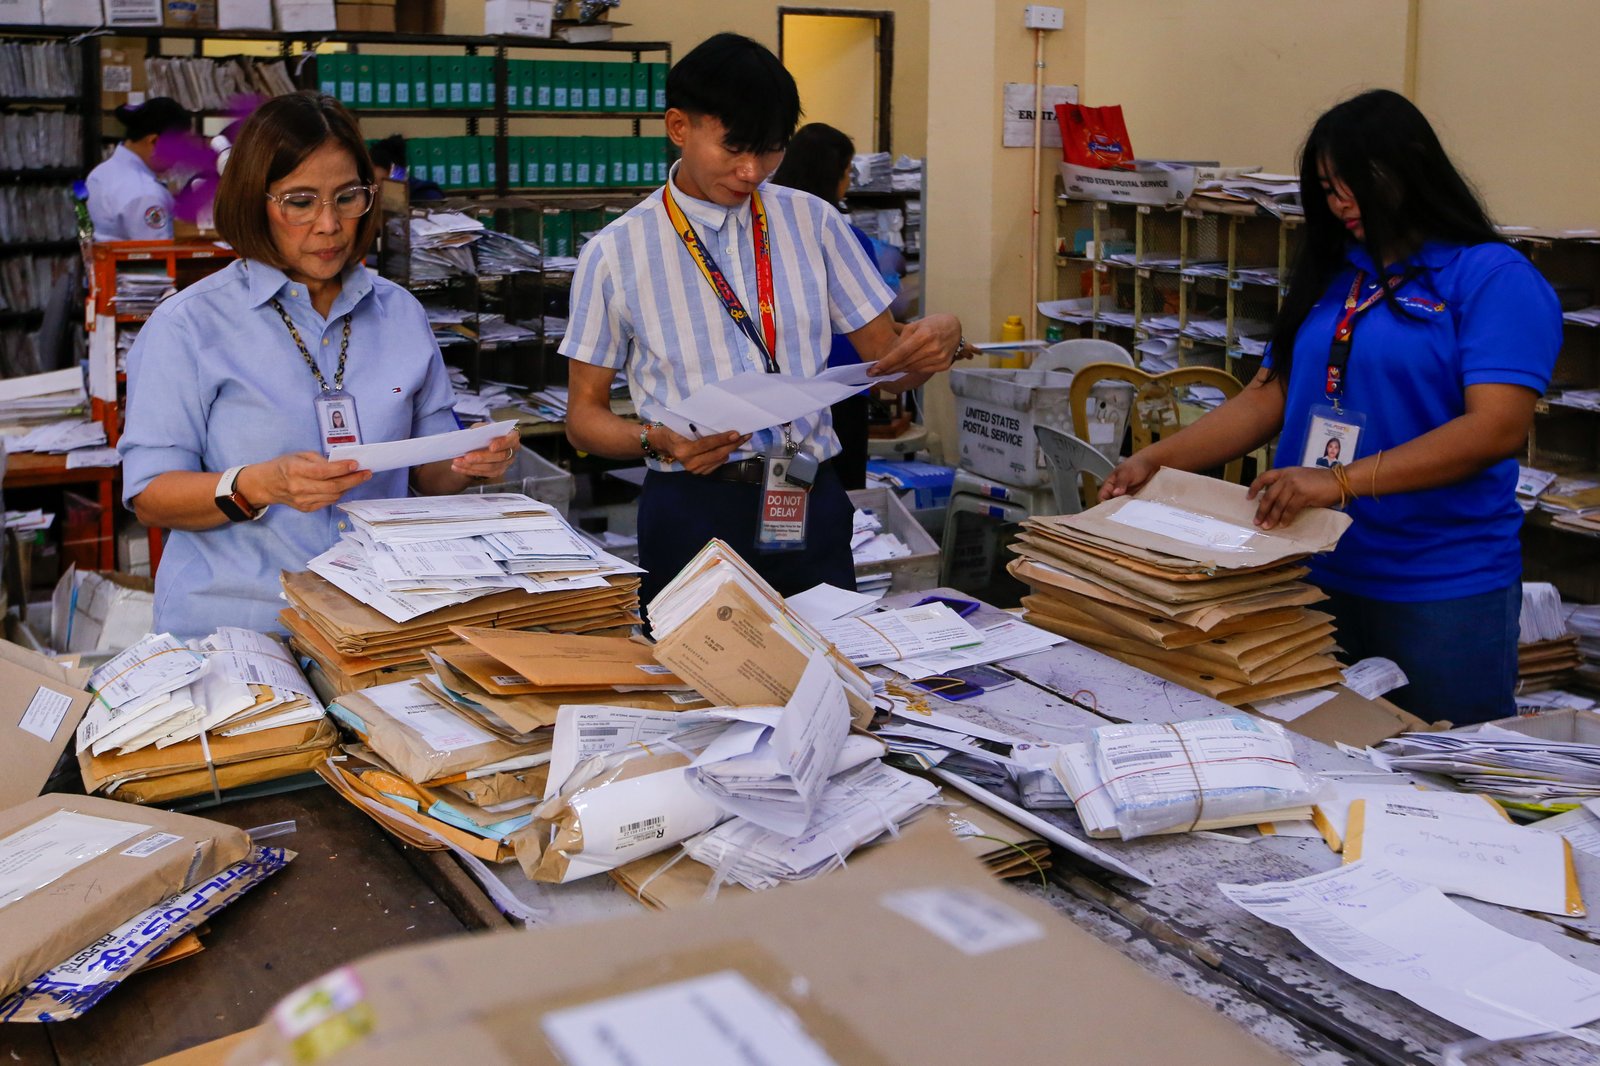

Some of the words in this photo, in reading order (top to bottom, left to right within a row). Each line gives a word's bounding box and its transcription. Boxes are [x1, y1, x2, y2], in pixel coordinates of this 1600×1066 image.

[1075, 175, 1094, 184] UNITED
[1095, 177, 1115, 186] STATES
[1116, 180, 1139, 188] POSTAL
[1140, 180, 1168, 188] SERVICE
[966, 406, 990, 422] UNITED
[991, 413, 1020, 431] STATES
[963, 421, 989, 438] POSTAL
[991, 428, 1023, 447] SERVICE
[767, 495, 781, 505] DO
[783, 496, 802, 506] NOT
[770, 507, 797, 517] DELAY
[656, 828, 664, 839] R
[71, 933, 117, 968] PHLPOST
